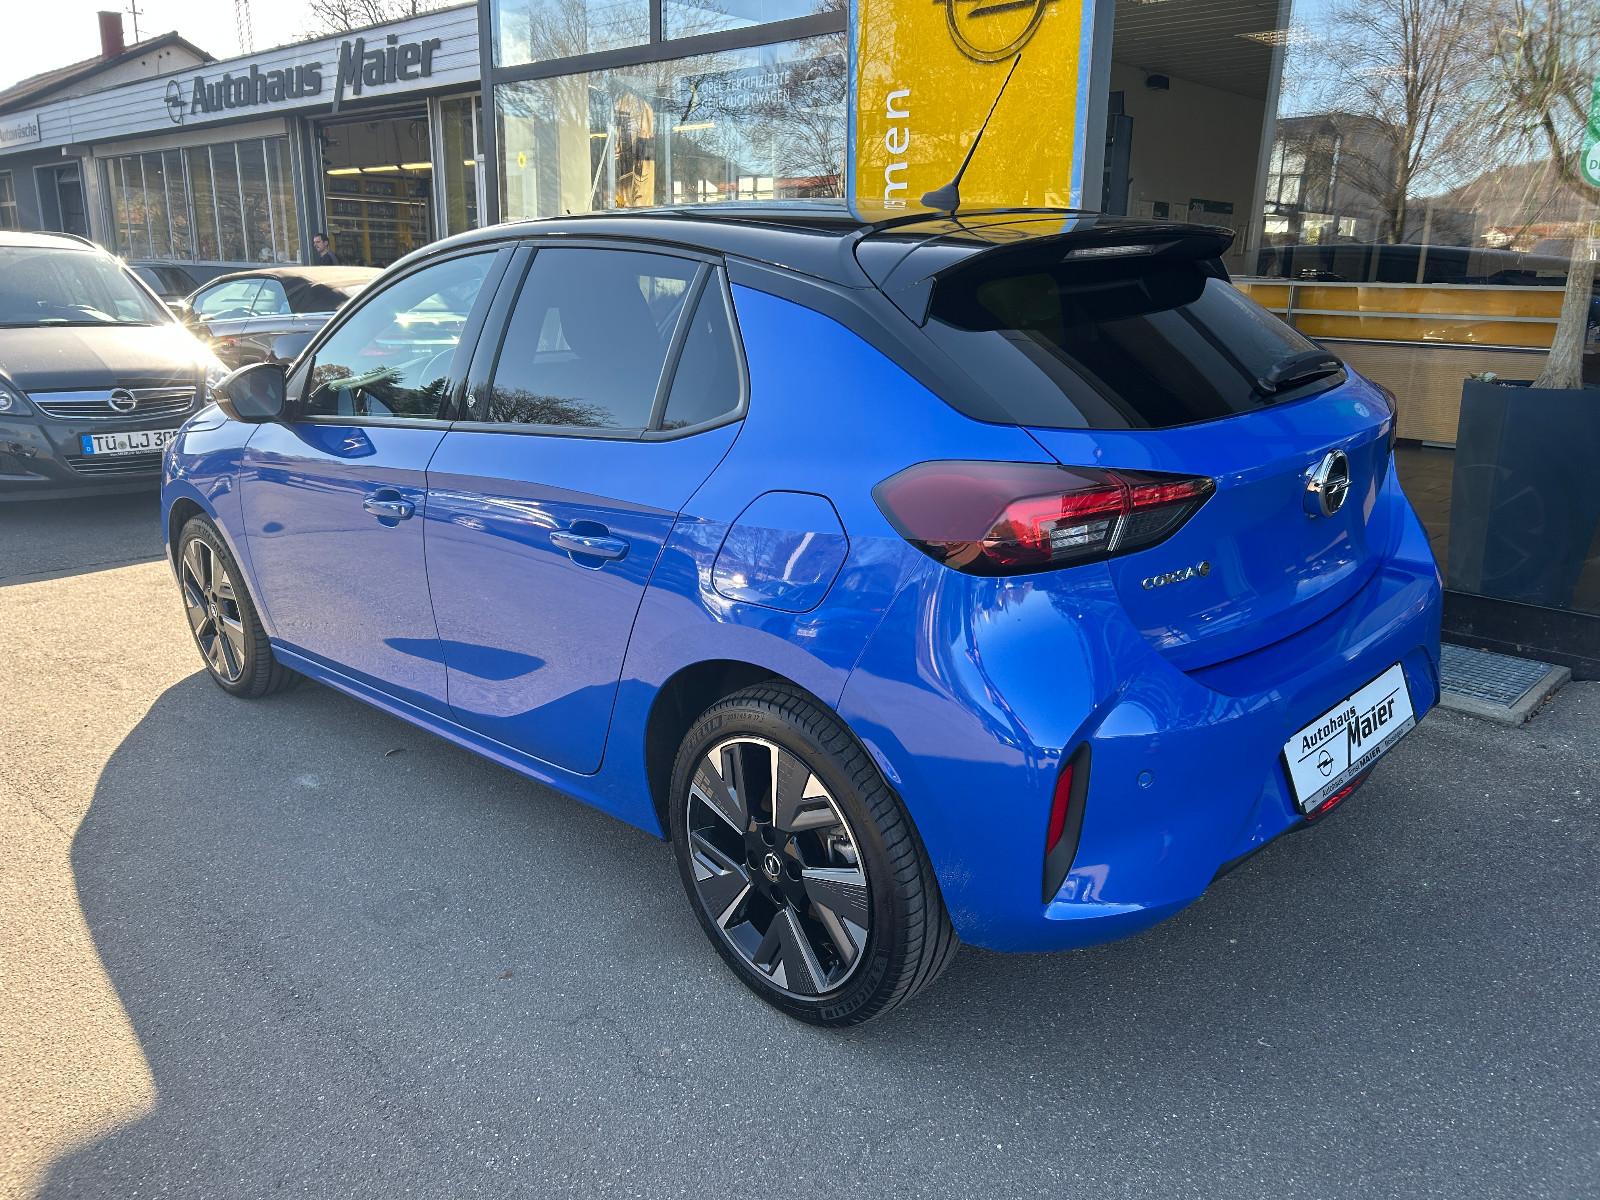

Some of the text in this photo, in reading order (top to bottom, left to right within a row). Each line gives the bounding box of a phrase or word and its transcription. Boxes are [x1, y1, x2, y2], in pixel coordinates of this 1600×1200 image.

[190, 34, 441, 115] Autohaus Maier
[726, 72, 790, 91] ZERTIFIZIERTE
[93, 430, 178, 452] TÜ LJ 30
[1302, 705, 1357, 754] Autohaus
[1347, 697, 1395, 767] Maier
[1359, 746, 1381, 768] MAIER
